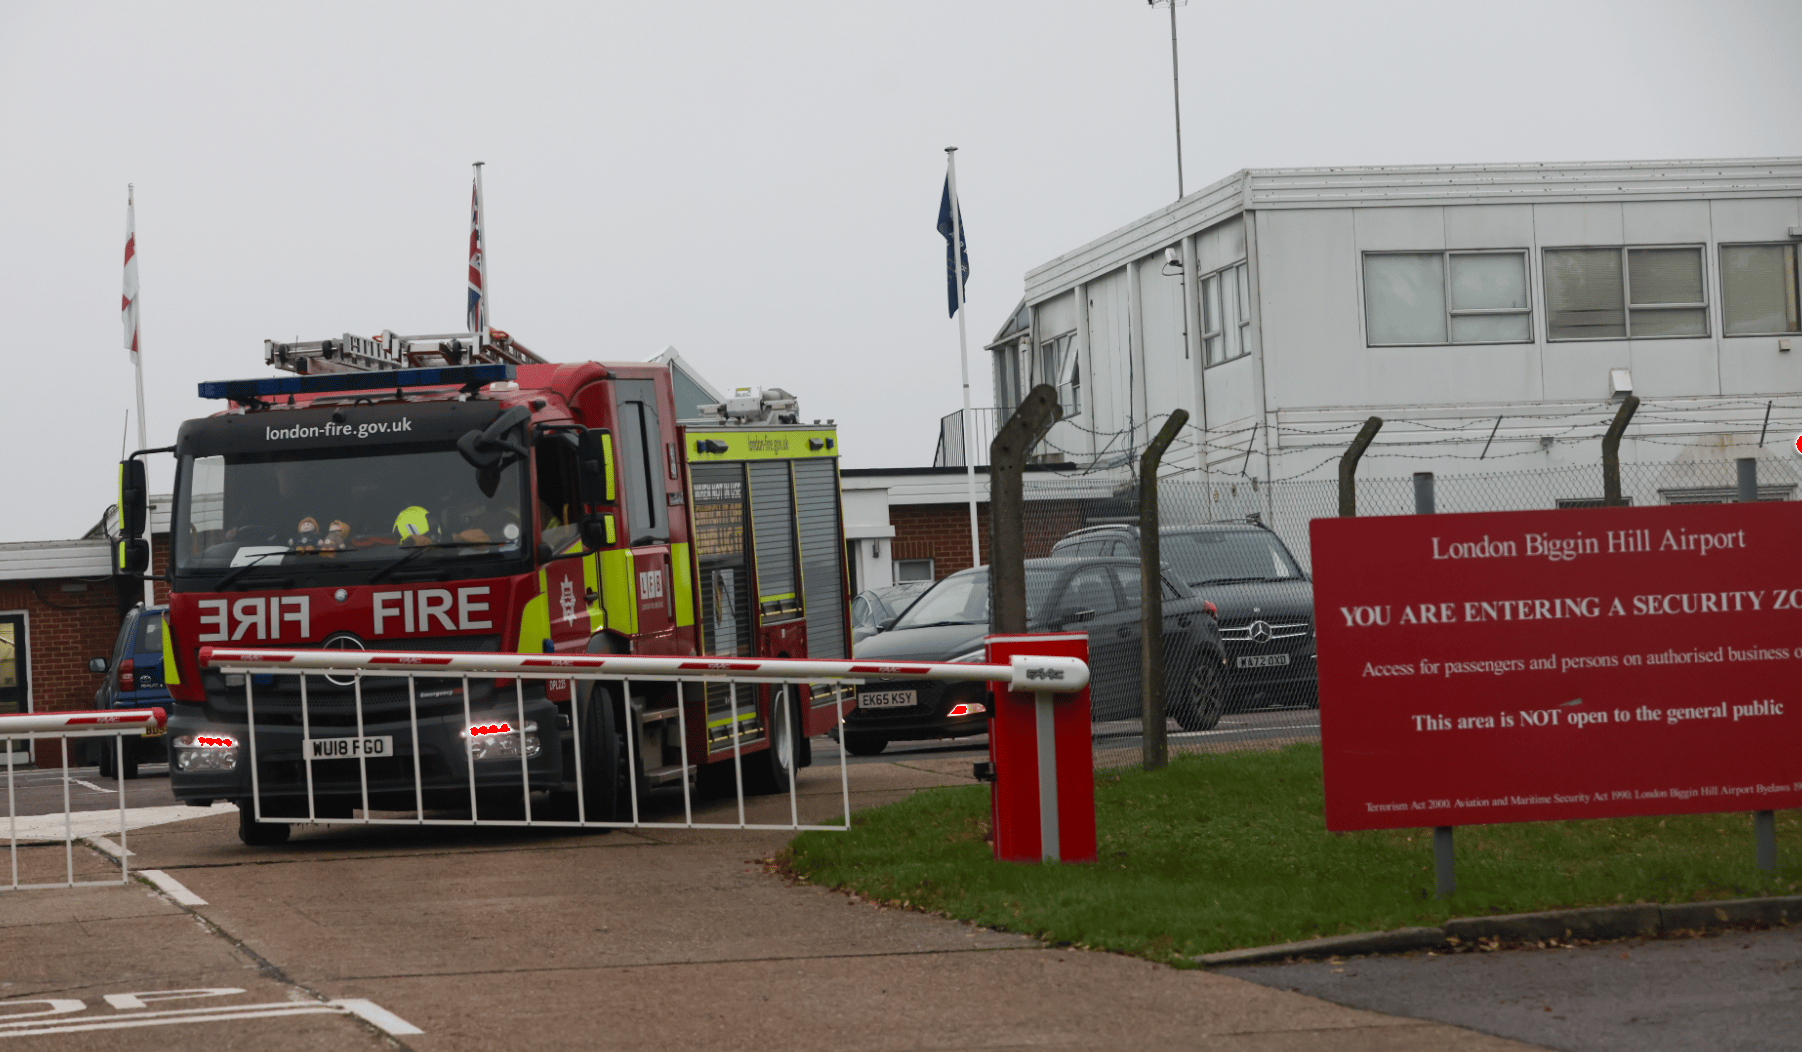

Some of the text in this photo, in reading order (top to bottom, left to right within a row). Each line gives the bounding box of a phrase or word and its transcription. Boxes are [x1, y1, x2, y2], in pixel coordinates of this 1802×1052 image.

[266, 417, 412, 440] london-fire.gov.uk
[1431, 527, 1746, 561] London Biggin Hill Airport
[640, 570, 664, 599] LFB
[372, 586, 493, 635] FIRE
[1340, 605, 1391, 627] YOU
[1399, 603, 1457, 624] ARE
[1464, 597, 1600, 622] ENTERING
[1608, 597, 1626, 616] A
[1633, 590, 1765, 616] SECURITY
[1026, 668, 1064, 680] FAAC
[1362, 662, 1415, 677] Access
[1420, 658, 1440, 674] for
[1444, 659, 1525, 678] passengers
[1529, 653, 1557, 670] and
[1561, 653, 1618, 673] persons
[1623, 654, 1642, 666] on
[1646, 647, 1724, 665] authorised
[1728, 645, 1790, 661] business
[863, 692, 912, 706] EK65 KSY
[1412, 699, 1784, 731] This area is NOT open to the general public
[313, 739, 383, 756] WU18 FGO
[1365, 801, 1408, 812] Terrorism
[1410, 800, 1426, 810] Act
[1454, 797, 1490, 808] Aviation
[1492, 796, 1508, 806] and
[1510, 794, 1552, 805] Maritime
[1553, 793, 1590, 804] Security
[1593, 791, 1608, 801] Act
[1634, 788, 1668, 799] London
[1669, 787, 1698, 799] Biggin
[1701, 786, 1718, 796] Hill
[1720, 785, 1754, 797] Airport
[1756, 783, 1790, 795] Byelaws
